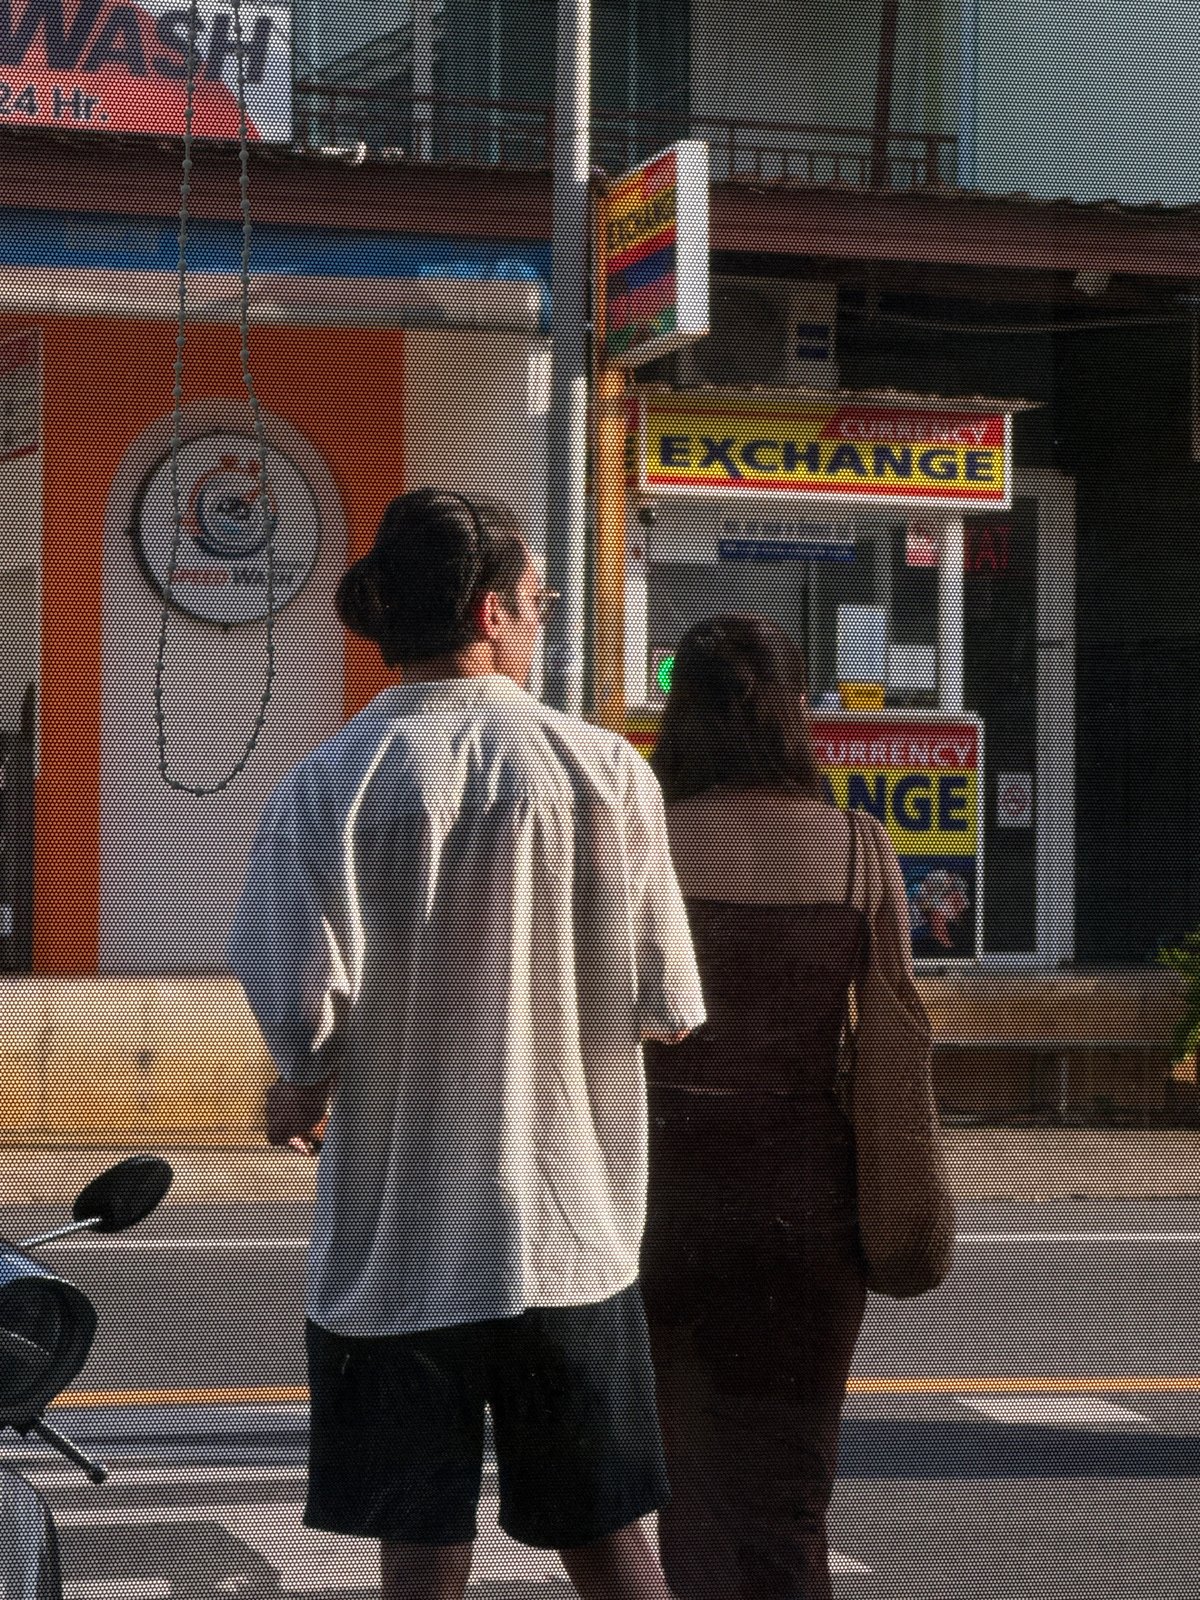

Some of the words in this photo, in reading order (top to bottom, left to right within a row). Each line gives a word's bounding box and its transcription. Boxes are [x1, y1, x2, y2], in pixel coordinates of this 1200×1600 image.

[0, 0, 273, 84] WASH
[52, 86, 109, 122] Hr.
[838, 416, 990, 445] CURRENCY
[658, 435, 996, 482] EXCHANGE
